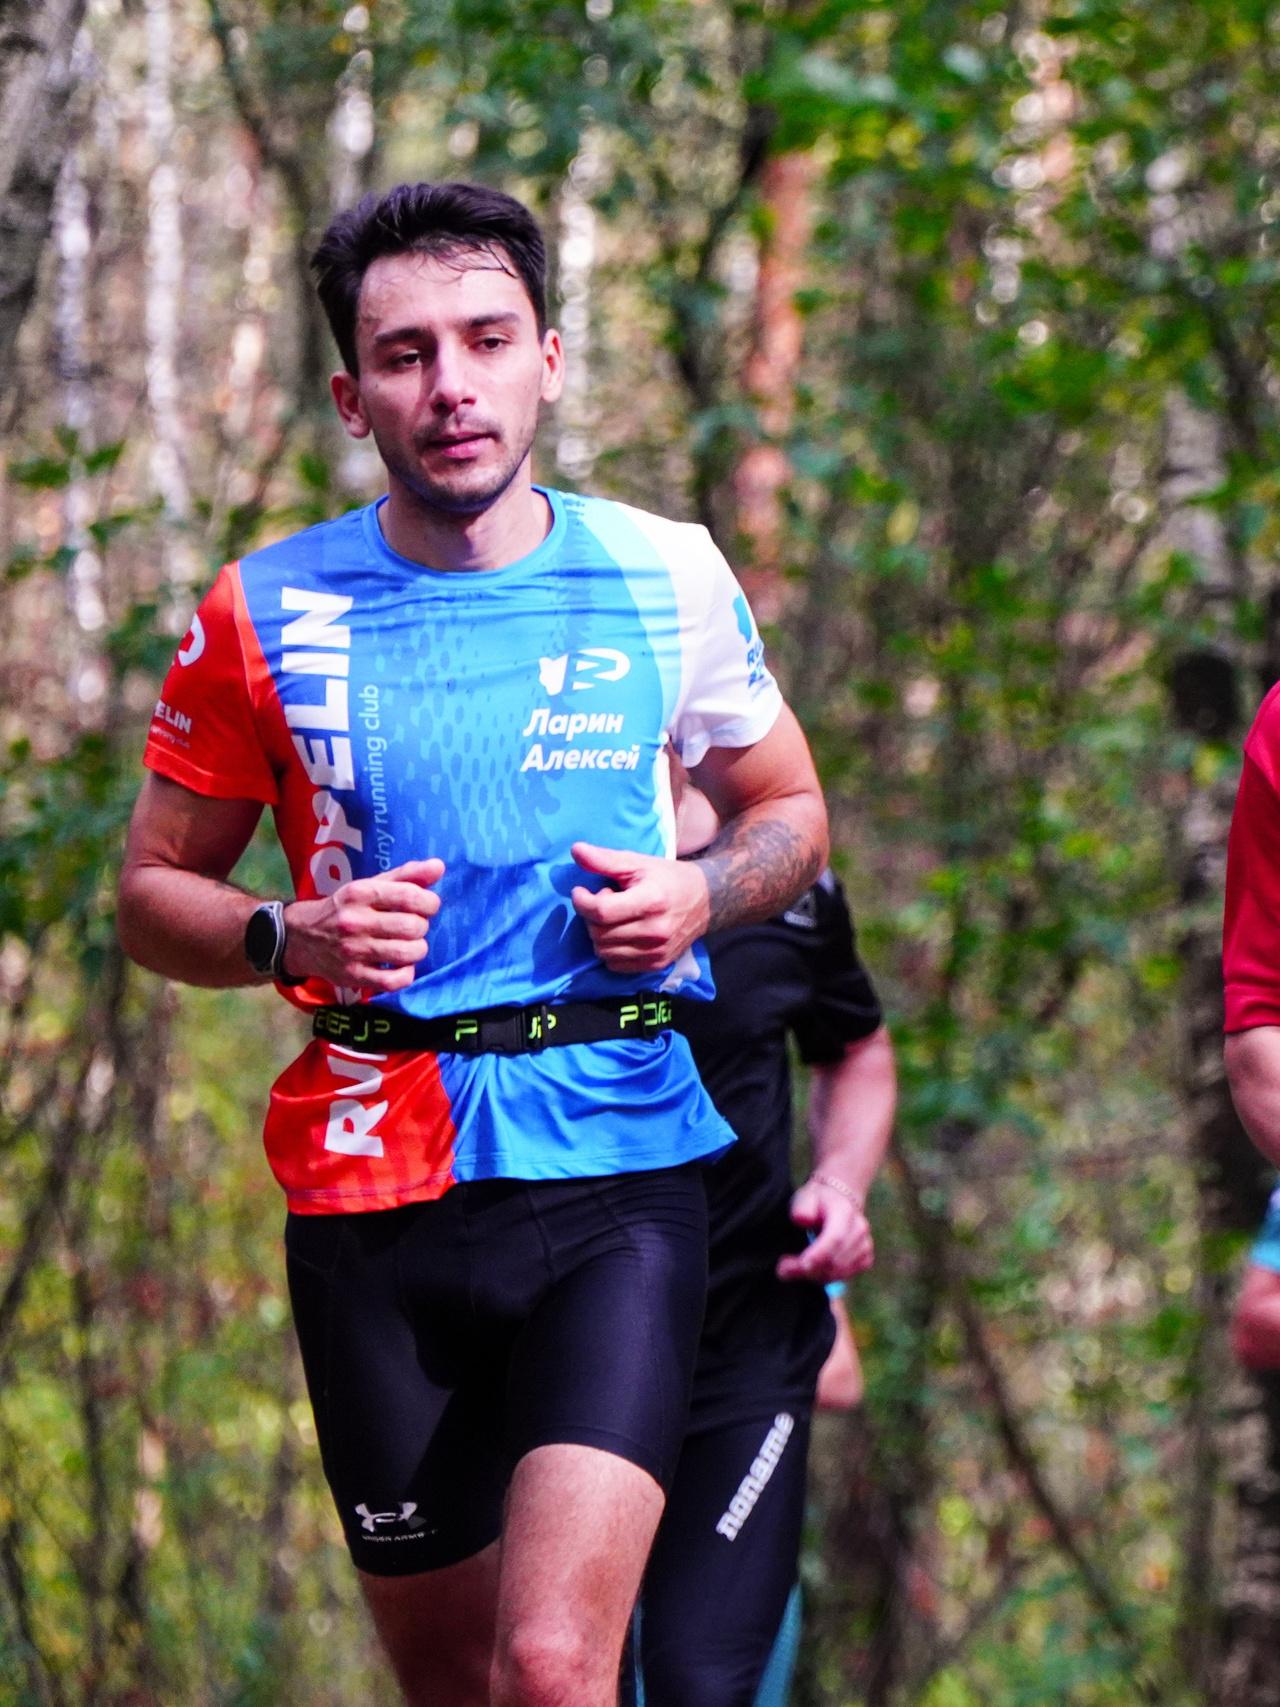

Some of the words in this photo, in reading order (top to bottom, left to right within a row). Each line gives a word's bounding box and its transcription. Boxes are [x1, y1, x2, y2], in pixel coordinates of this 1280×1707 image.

[358, 684, 379, 731] club
[523, 708, 624, 741] Ларин
[364, 737, 388, 815] running
[520, 744, 640, 773] Алексей
[281, 586, 388, 1158] RUPPELIN
[716, 1412, 795, 1542] noname
